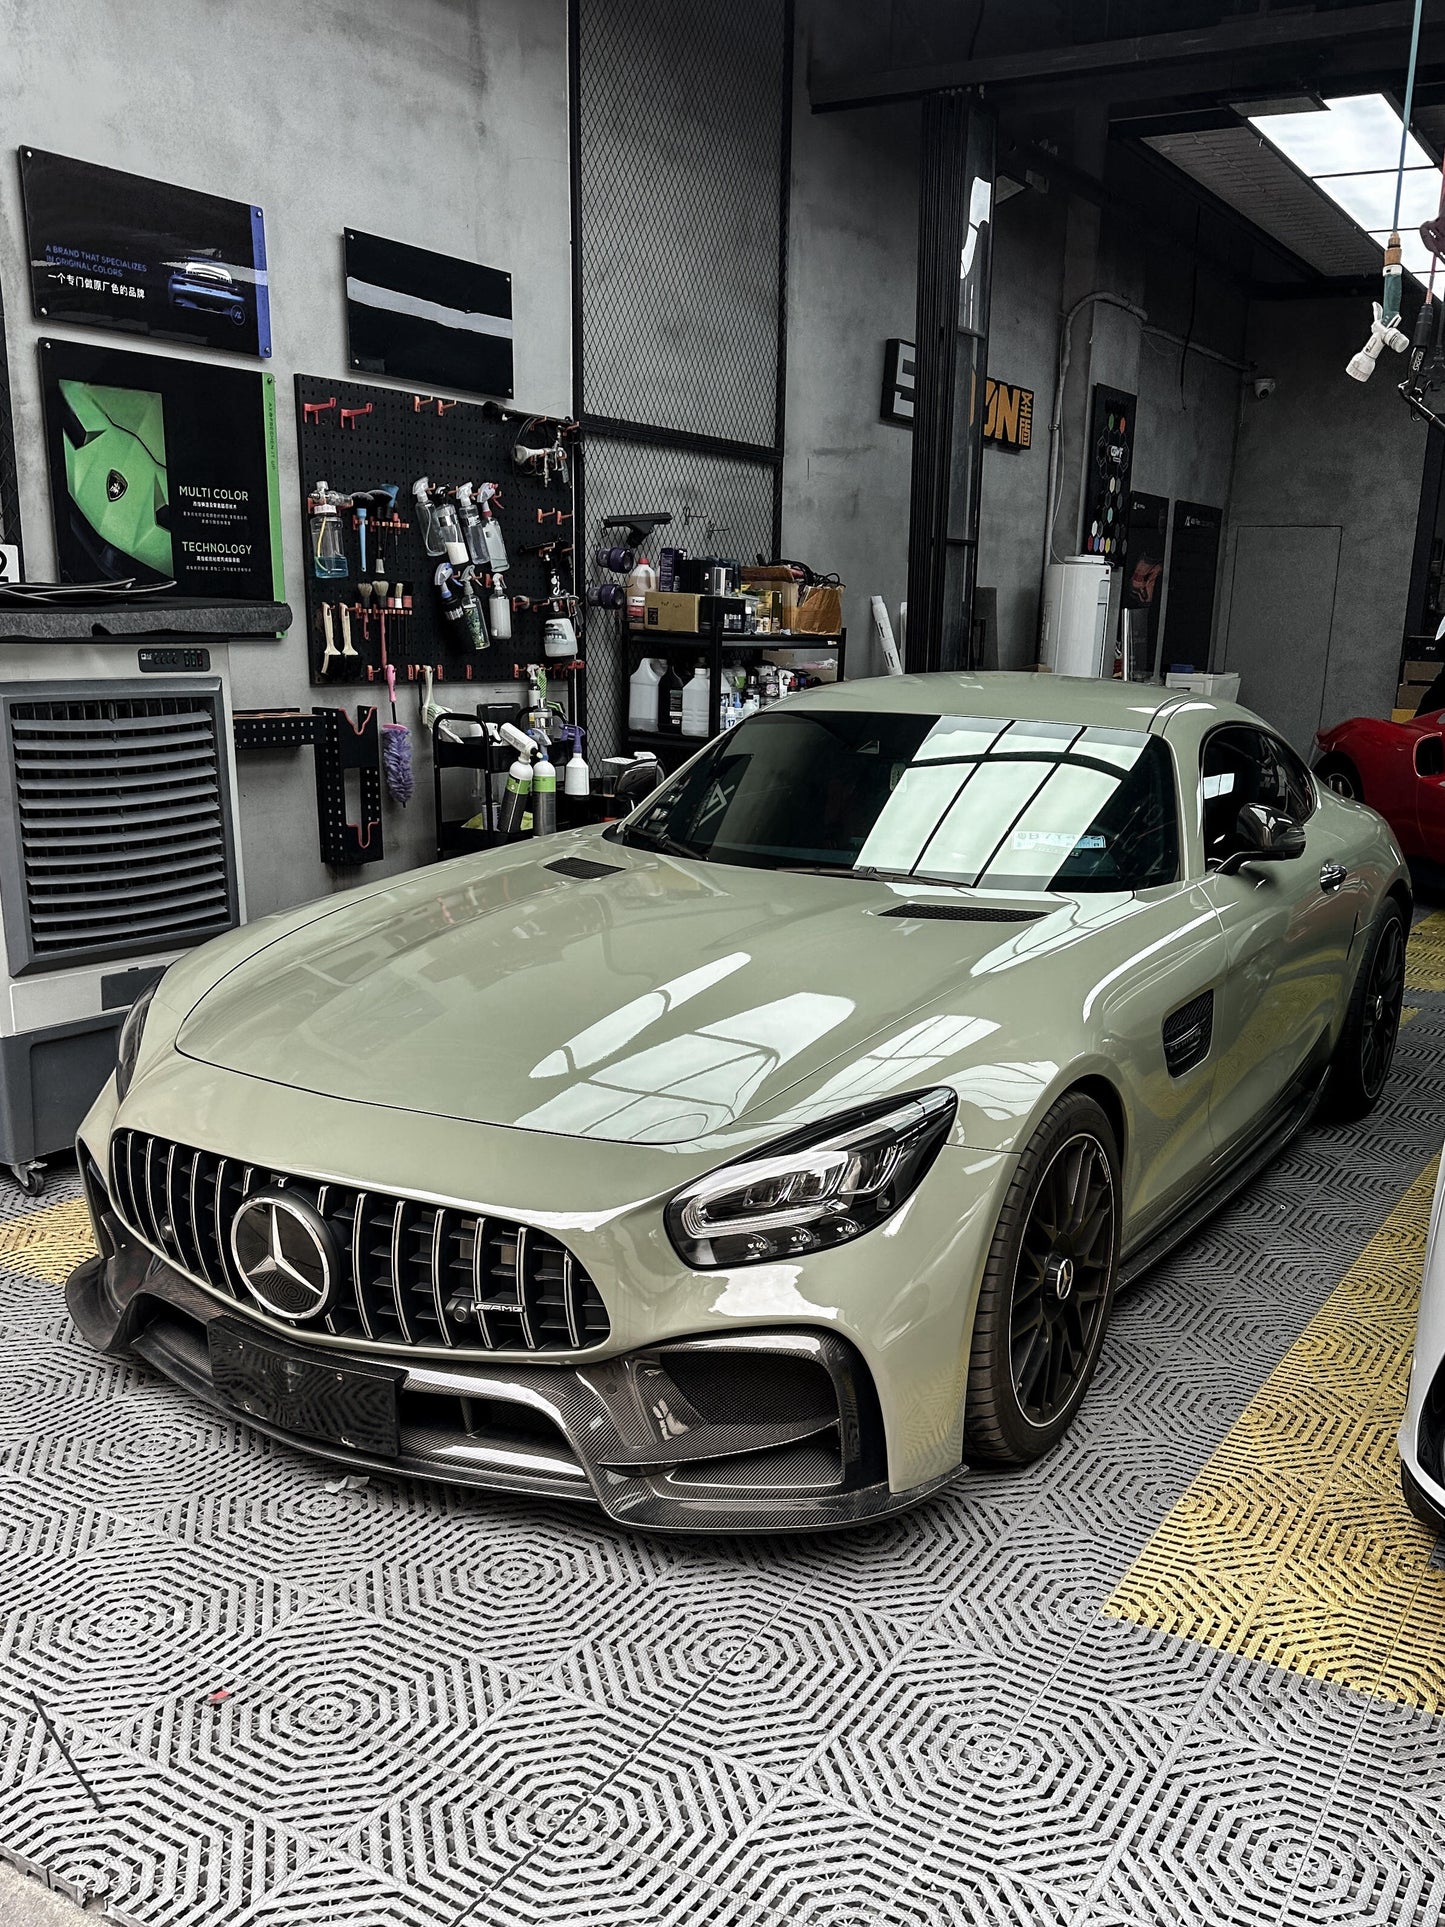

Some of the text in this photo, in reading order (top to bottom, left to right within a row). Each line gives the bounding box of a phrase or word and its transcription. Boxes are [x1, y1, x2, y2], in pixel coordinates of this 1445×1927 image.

[45, 244, 147, 272] A BRAND THAT SPECIALIZES
[46, 255, 123, 277] IN ORIGINAL COLORS
[47, 272, 145, 299] 一个专门做原厂色的品牌
[179, 485, 249, 502] MULTI COLOR
[181, 541, 252, 555] TECHNOLOGY
[490, 1304, 523, 1312] AMG
